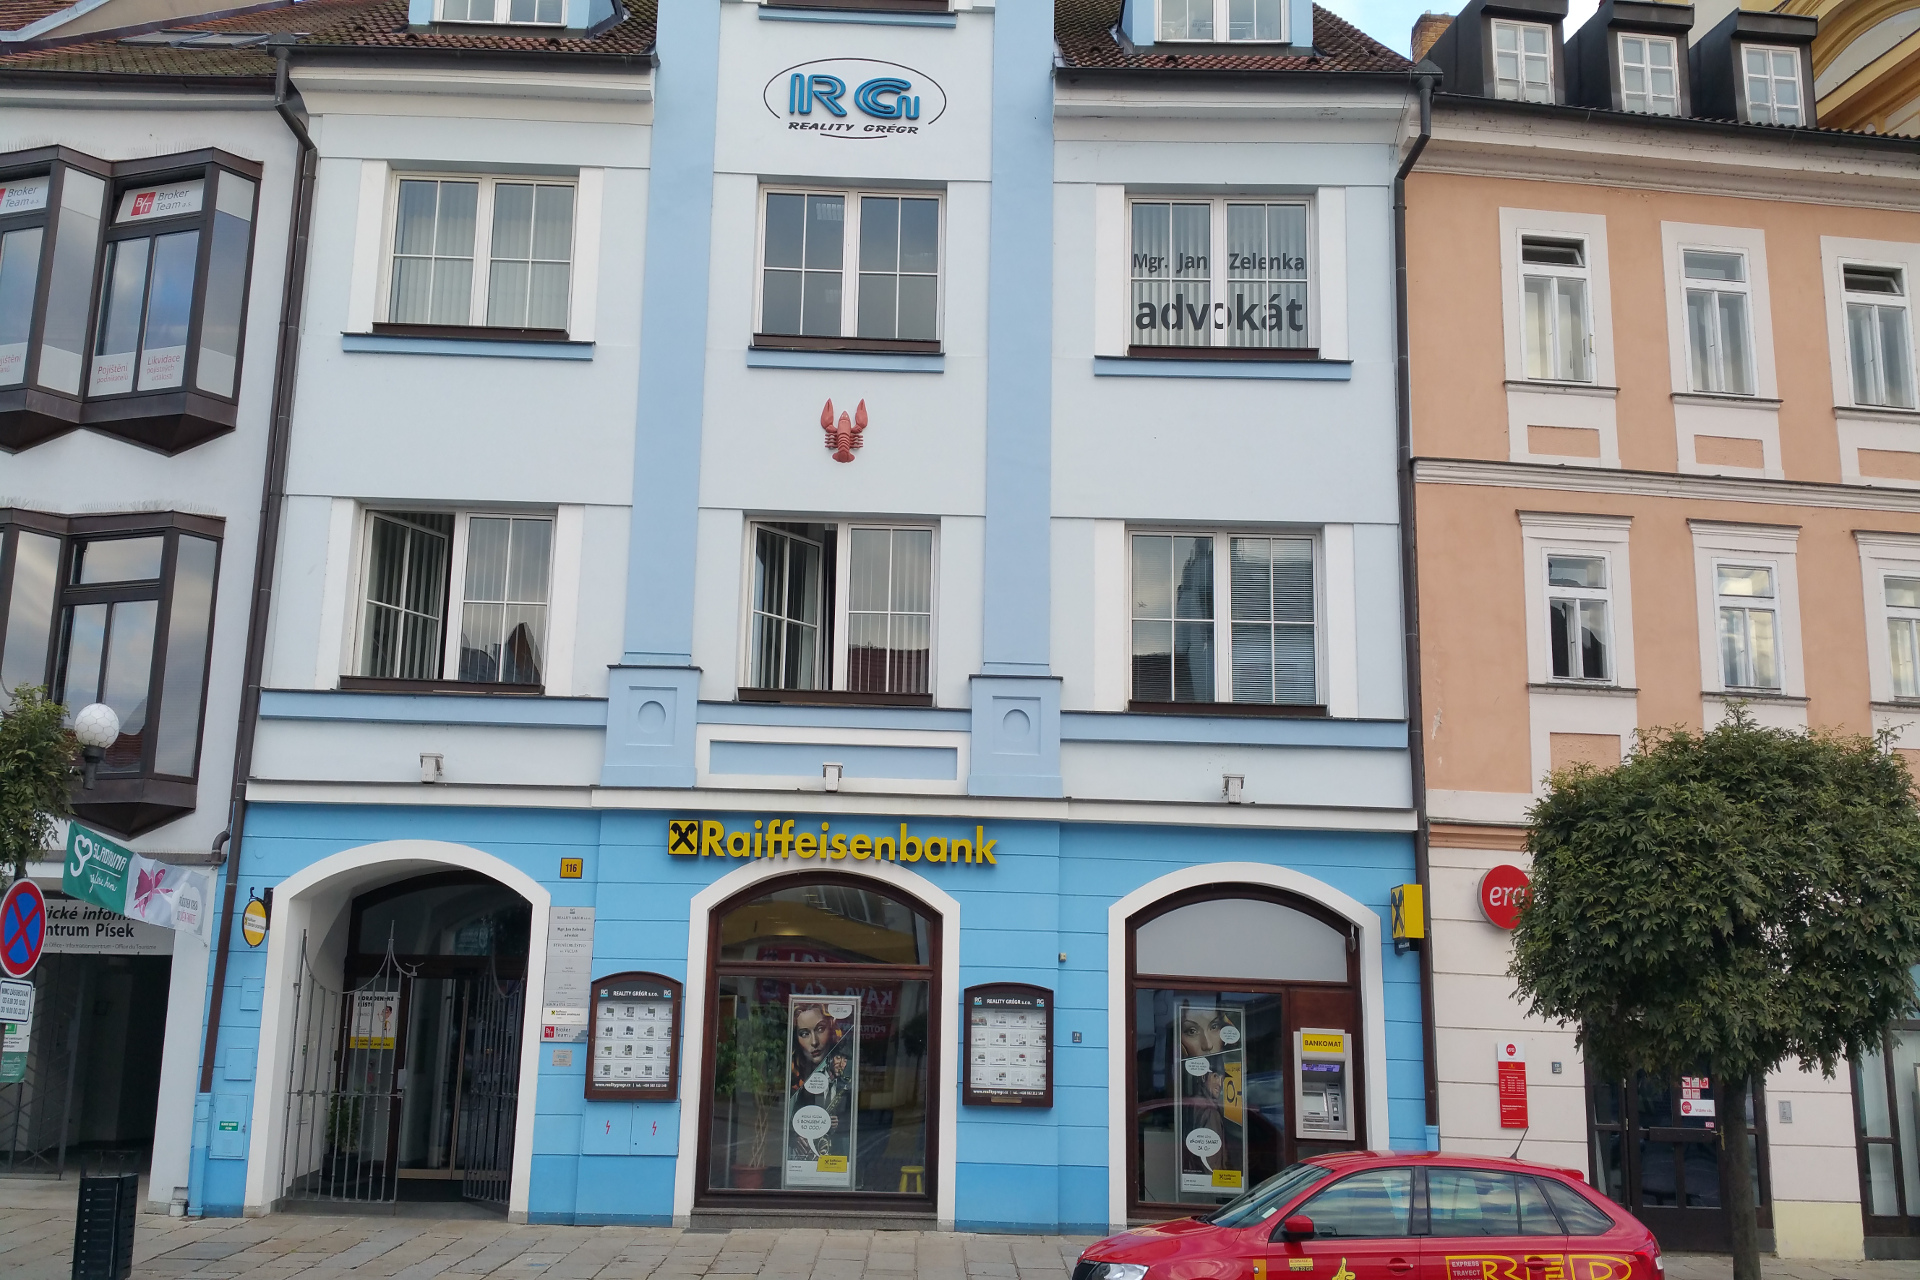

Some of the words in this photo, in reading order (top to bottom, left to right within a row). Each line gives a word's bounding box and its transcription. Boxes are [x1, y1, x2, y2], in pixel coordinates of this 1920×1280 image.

[788, 121, 855, 132] REALITY
[863, 123, 919, 135] GRÉGR
[7, 186, 38, 198] Broker
[157, 189, 190, 201] Broker
[5, 198, 29, 208] Team
[156, 201, 181, 212] Team
[1133, 253, 1168, 272] Mgr.
[1176, 252, 1208, 273] Jan
[1229, 252, 1305, 271] Zelenka
[1135, 293, 1303, 331] advokát
[147, 354, 181, 366] Likvidace
[97, 362, 129, 375] Pojištění
[701, 819, 998, 865] Raiffeisenbank
[565, 863, 577, 873] 116
[46, 923, 90, 937] ntrum
[95, 922, 135, 938] Písek
[632, 989, 648, 997] GRÉGR
[1304, 1039, 1341, 1048] BANKOMAT
[1451, 1260, 1480, 1268] EXPRESS
[1452, 1269, 1481, 1277] TRAYECT
